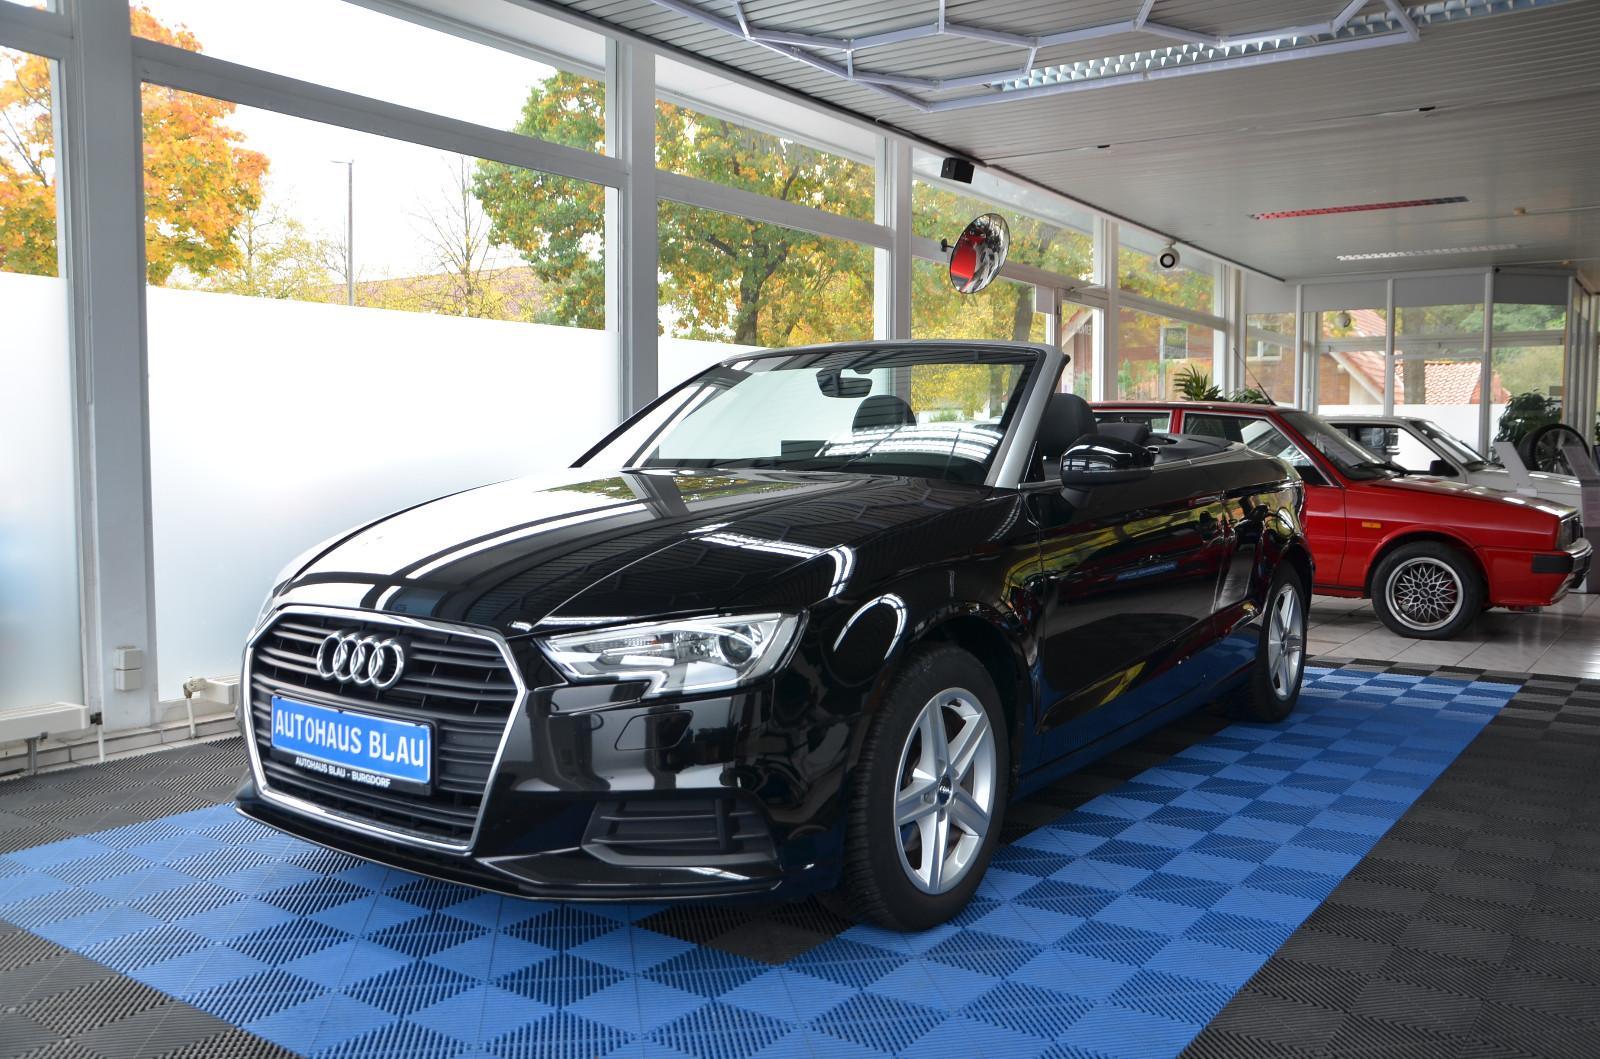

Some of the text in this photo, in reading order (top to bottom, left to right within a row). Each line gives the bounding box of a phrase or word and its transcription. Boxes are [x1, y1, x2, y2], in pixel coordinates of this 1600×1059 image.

[275, 709, 424, 767] AUTOHAUS BLAU
[295, 756, 328, 773] AUTOHAUS
[328, 765, 346, 778] BLAU
[352, 770, 391, 788] BURGDORF
